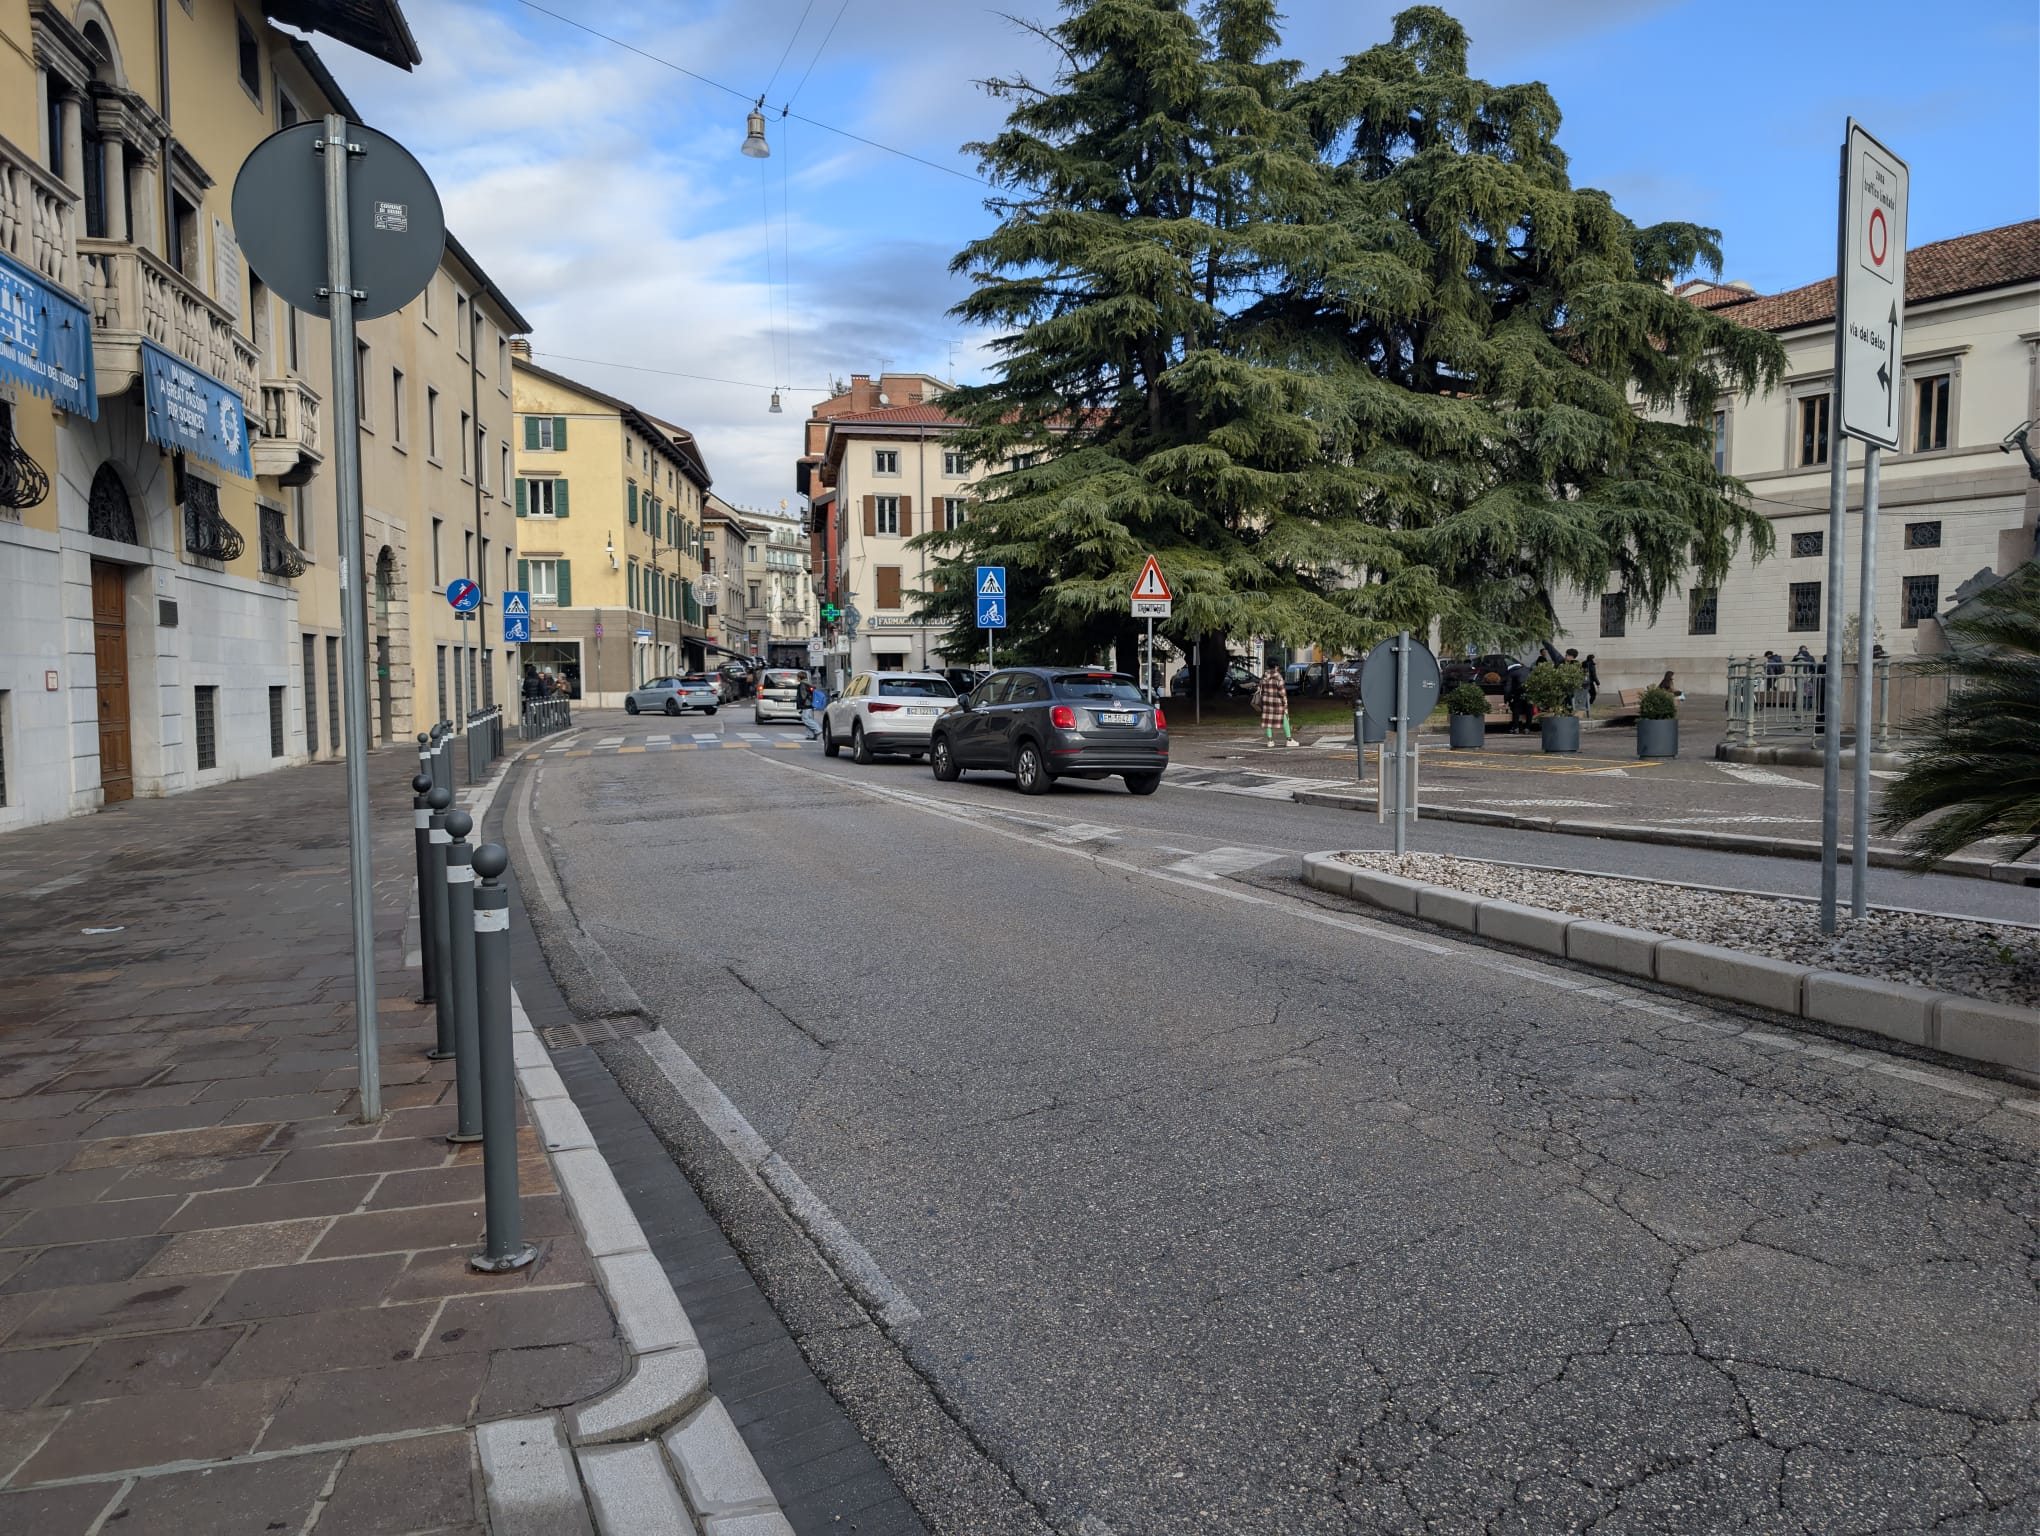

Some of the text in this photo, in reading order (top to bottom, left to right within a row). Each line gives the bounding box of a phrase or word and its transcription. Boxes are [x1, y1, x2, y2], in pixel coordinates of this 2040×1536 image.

[1864, 177, 1879, 200] traffico
[1849, 321, 1885, 352] via del Gelso
[17, 350, 47, 376] MANGILLI
[47, 365, 58, 382] DEL
[60, 371, 79, 391] TORSO
[179, 368, 196, 391] UDINE
[160, 378, 207, 415] A GREAT PASSION
[167, 399, 205, 432] FOR SCIENCES
[879, 617, 915, 625] FARMACIA
